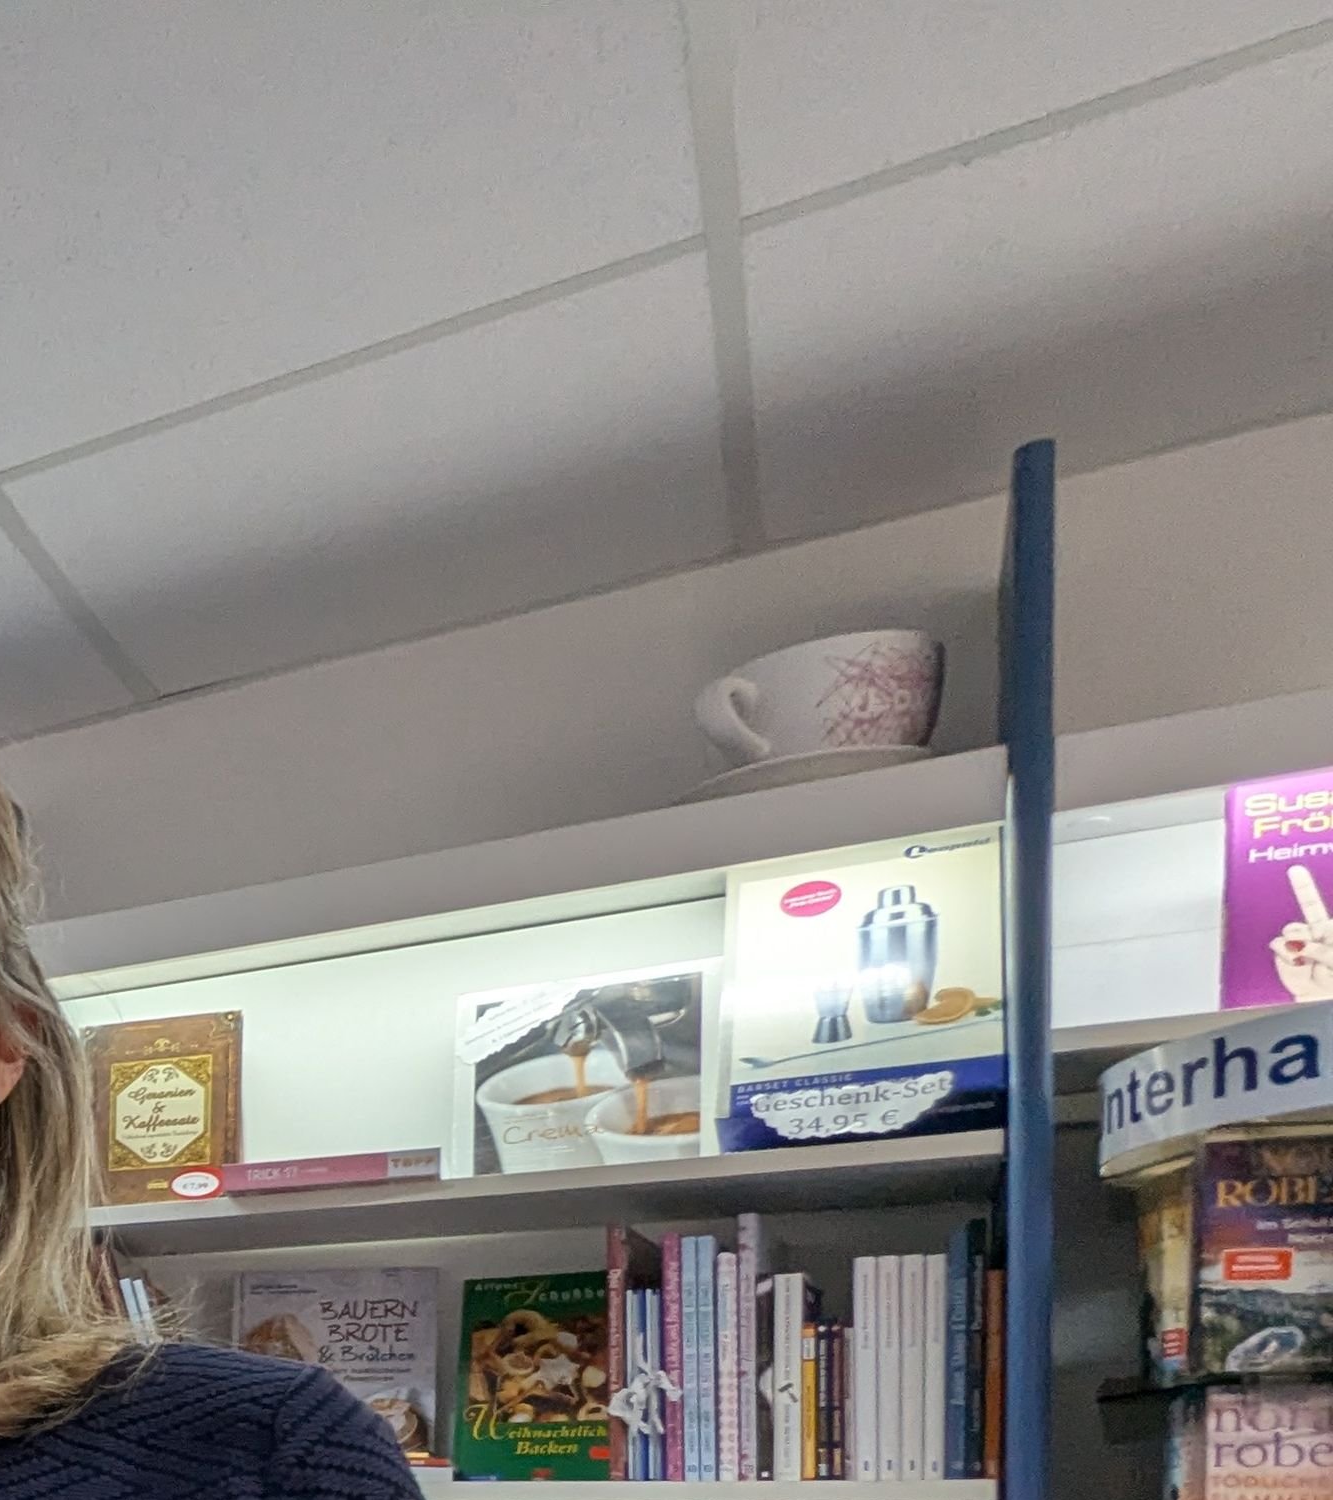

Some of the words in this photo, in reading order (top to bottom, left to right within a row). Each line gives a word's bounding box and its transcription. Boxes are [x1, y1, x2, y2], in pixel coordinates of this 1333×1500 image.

[795, 1073, 854, 1087] CLASSIC
[754, 1076, 952, 1114] Geschenk-Set
[789, 1113, 868, 1136] 34,95
[882, 1109, 901, 1127] €
[503, 1124, 605, 1145] Crema
[319, 1299, 419, 1321] BAUERN
[327, 1322, 410, 1343] BROTE
[340, 1344, 416, 1362] Brötchen
[515, 1440, 580, 1456] Backen
